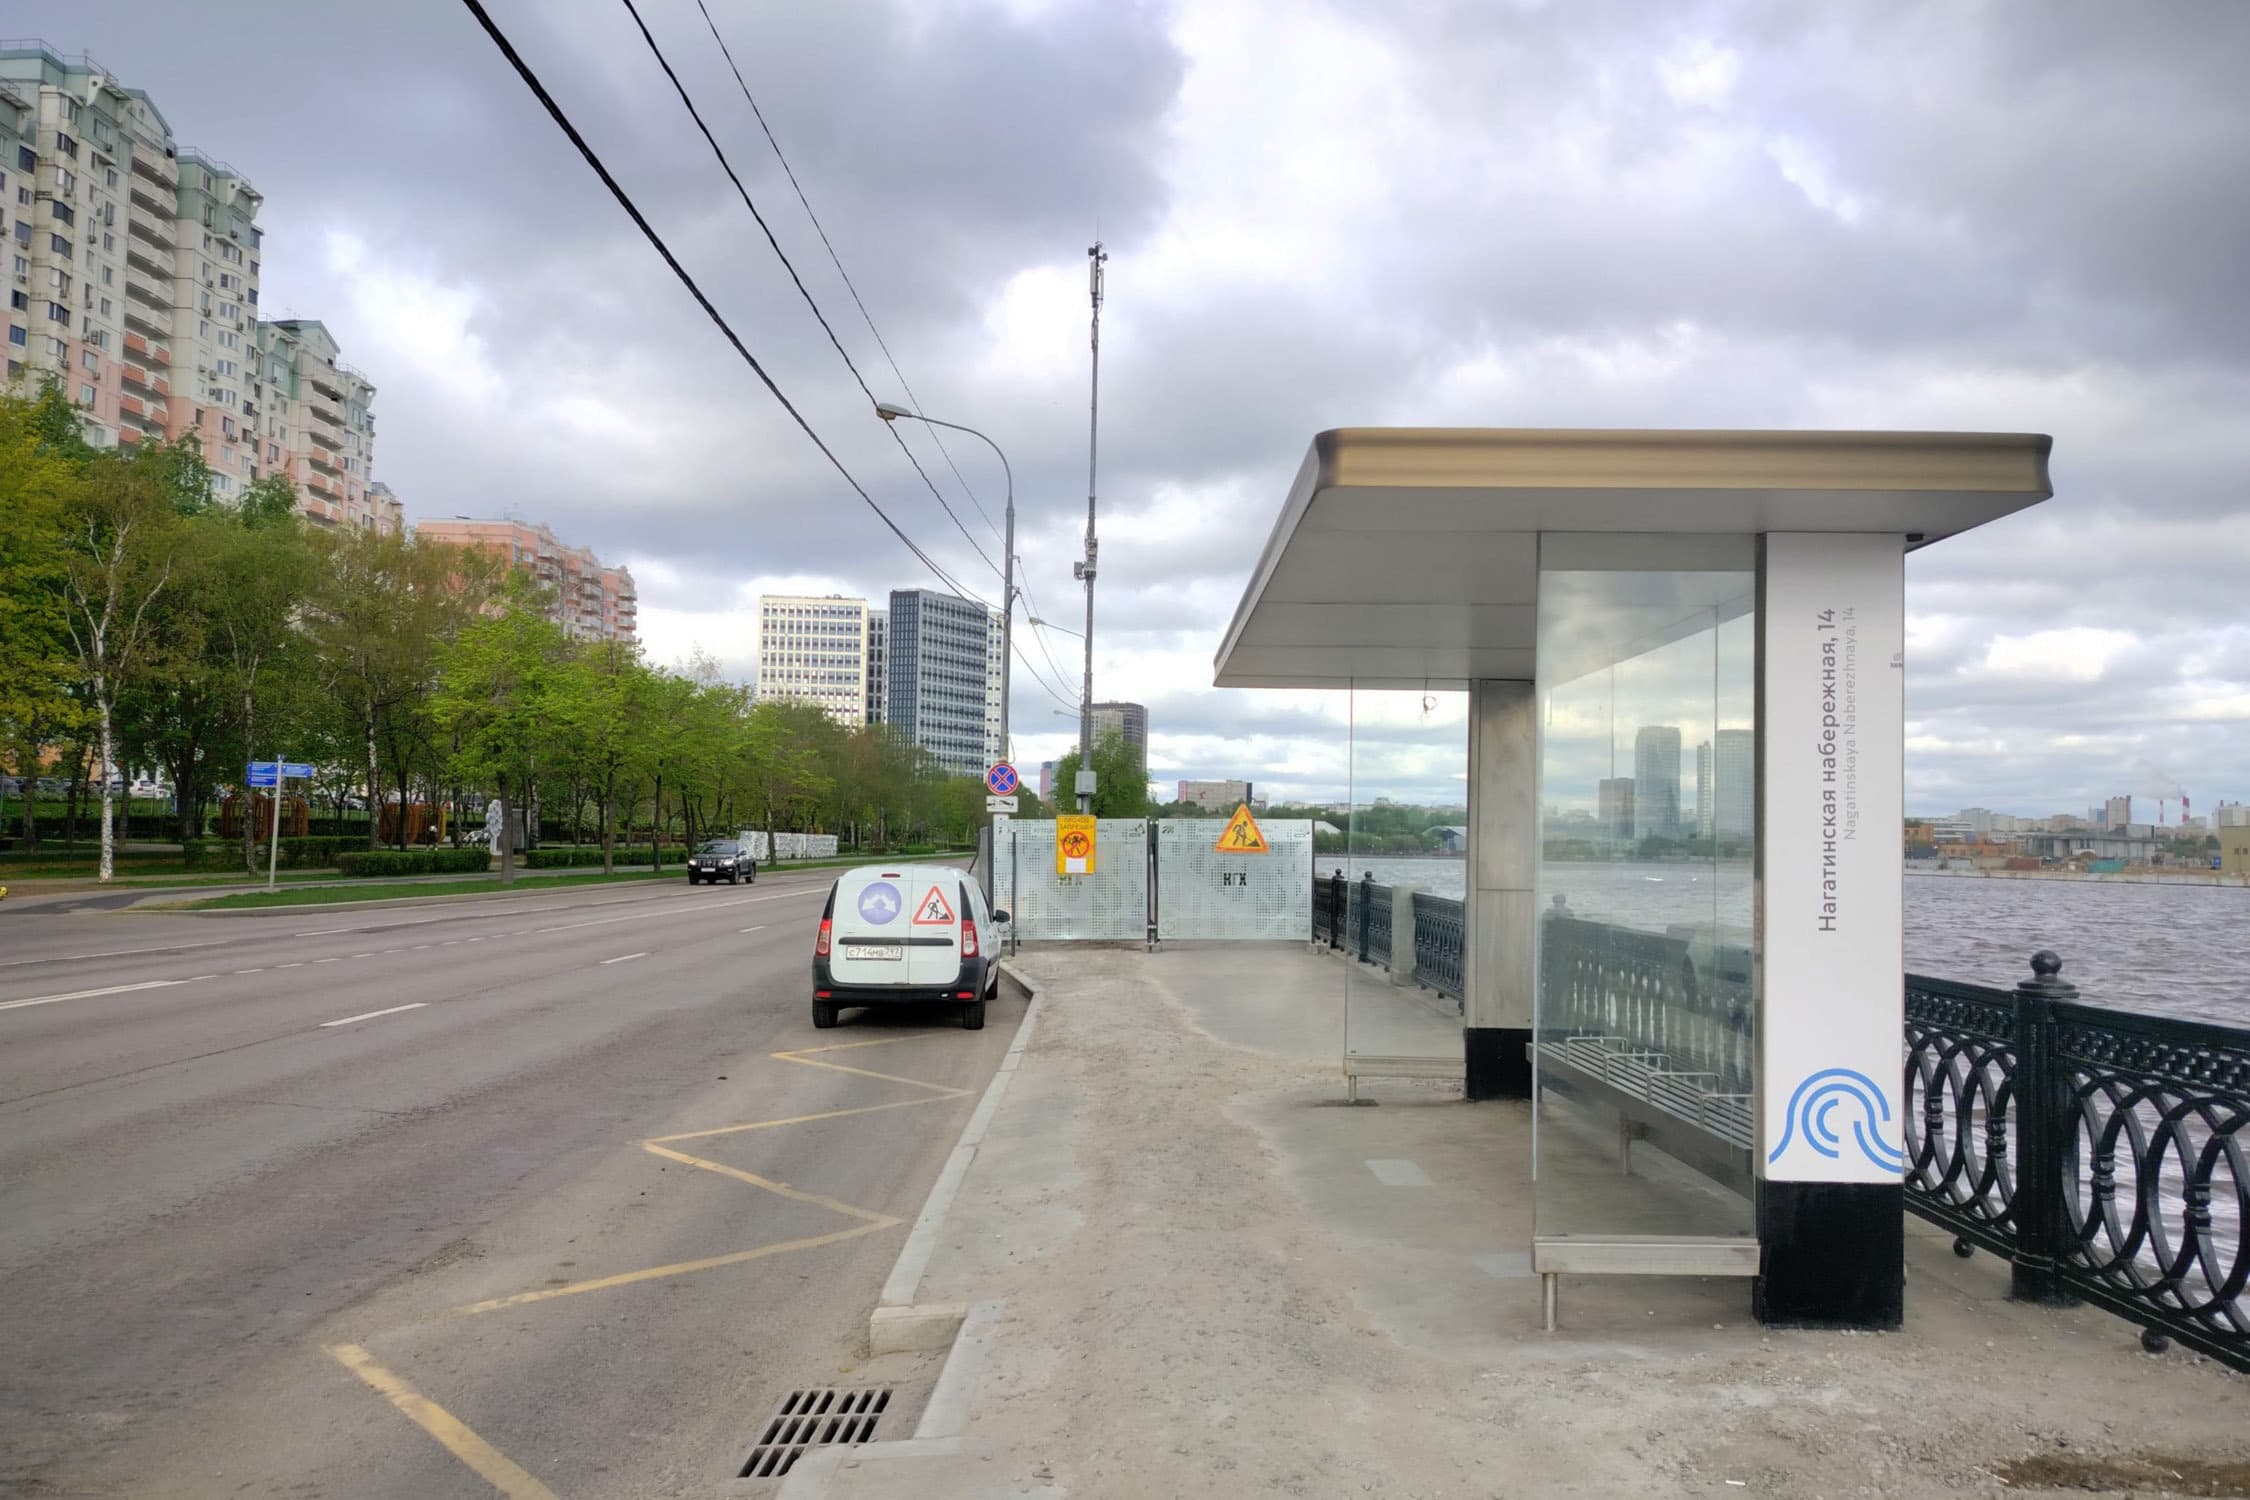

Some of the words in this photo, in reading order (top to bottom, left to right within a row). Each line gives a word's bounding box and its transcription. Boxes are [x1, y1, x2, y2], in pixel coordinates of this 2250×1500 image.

[1817, 608, 1836, 631] 14
[1843, 607, 1856, 622] 14
[1817, 637, 1841, 782] набережная,
[1843, 625, 1860, 735] Naberezhnaya,
[1843, 739, 1860, 841] Nagatinskaya
[1817, 789, 1837, 932] Нагатинская
